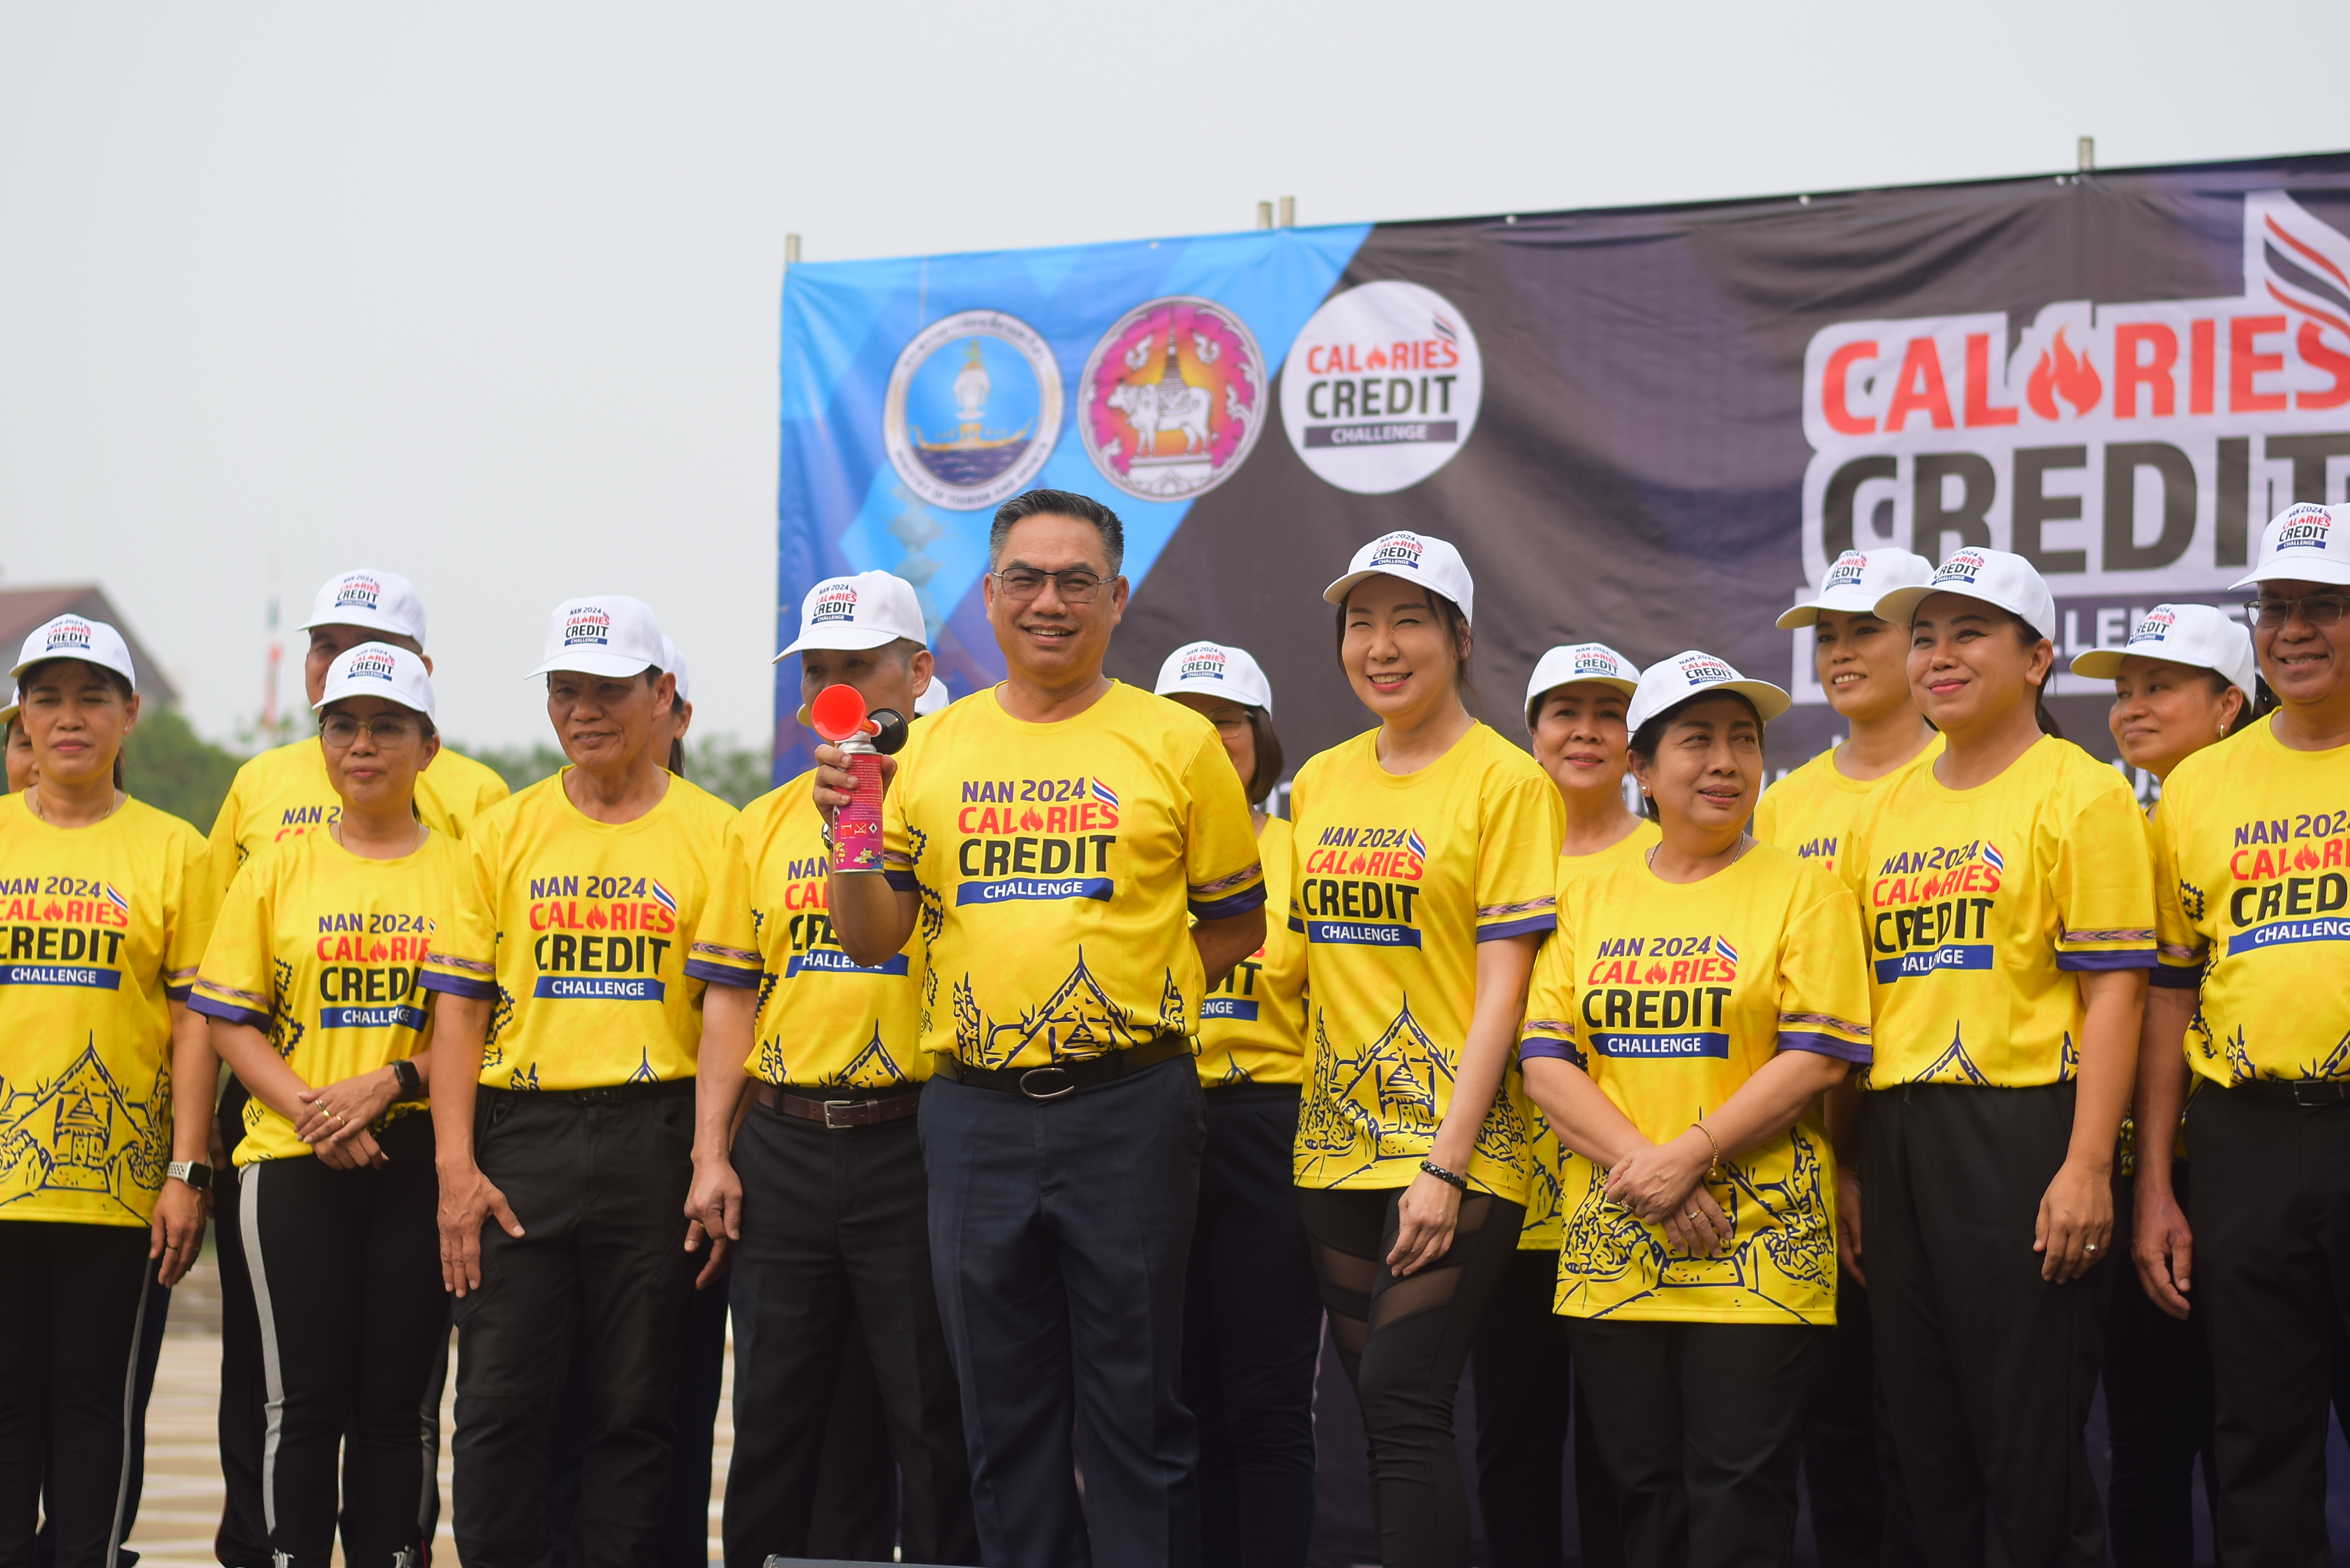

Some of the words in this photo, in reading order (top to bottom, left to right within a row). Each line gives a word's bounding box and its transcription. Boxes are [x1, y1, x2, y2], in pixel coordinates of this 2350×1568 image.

[1307, 375, 1457, 420] CREDIT
[1331, 424, 1427, 443] CHALLENGE
[896, 448, 930, 493] MINISTRY
[932, 489, 943, 500] OF
[948, 493, 991, 505] TOURISM
[995, 479, 1016, 496] AND
[1018, 442, 1048, 481] SPORTS
[1379, 535, 1394, 544] NAN
[2279, 526, 2329, 541] CREDIT
[1372, 547, 1421, 562] CREDIT
[1945, 556, 1983, 567] ALORIES
[337, 590, 378, 603] CREDIT
[819, 585, 830, 596] NAN
[569, 607, 582, 616] NAN
[813, 602, 855, 617] CREDIT
[47, 632, 90, 644] CREDIT
[565, 625, 608, 638] CREDIT
[1592, 646, 1609, 655] 2024
[350, 661, 394, 674] CREDIT
[1181, 661, 1224, 673] CREDIT
[1575, 659, 1618, 674] CREDIT
[1685, 667, 1733, 679] CREDIT
[962, 781, 1015, 803] NAN
[1020, 777, 1086, 802] 2024
[282, 805, 322, 825] NAN
[1317, 826, 1359, 847] NAN
[1358, 827, 1407, 848] 2024
[2234, 819, 2288, 849] NAN
[2294, 810, 2350, 838] 202
[959, 834, 1116, 877] CREDIT
[1798, 837, 1838, 859] NAN
[1878, 851, 1928, 877] NAN
[1927, 839, 1980, 870] 2024
[787, 856, 828, 881] NAN
[2230, 837, 2350, 880] CALORI
[0, 878, 39, 895] NAN
[44, 877, 101, 898] 2024
[531, 875, 578, 900] NAN
[586, 875, 646, 899] 2024
[983, 881, 1084, 899] CHALLENGE
[1302, 878, 1420, 923] CREDIT
[2230, 872, 2350, 928] CRED
[318, 913, 363, 933] NAN
[370, 914, 424, 933] 2024
[1321, 925, 1400, 941] CHALLENGE
[1873, 897, 1995, 953] CREDIT
[2254, 921, 2350, 944] CHALLENG
[317, 937, 431, 963] CALORI
[534, 933, 671, 975] CREDIT
[1596, 937, 1645, 960] NAN
[1649, 936, 1712, 957] 2024
[801, 953, 883, 970] HALLE
[1900, 949, 1964, 972] HALLENGE
[11, 967, 96, 984] CHALLENGE
[551, 981, 644, 995] CHALLENGE
[1582, 987, 1732, 1028] CREDIT
[1607, 1037, 1701, 1053] CHALLENGE
